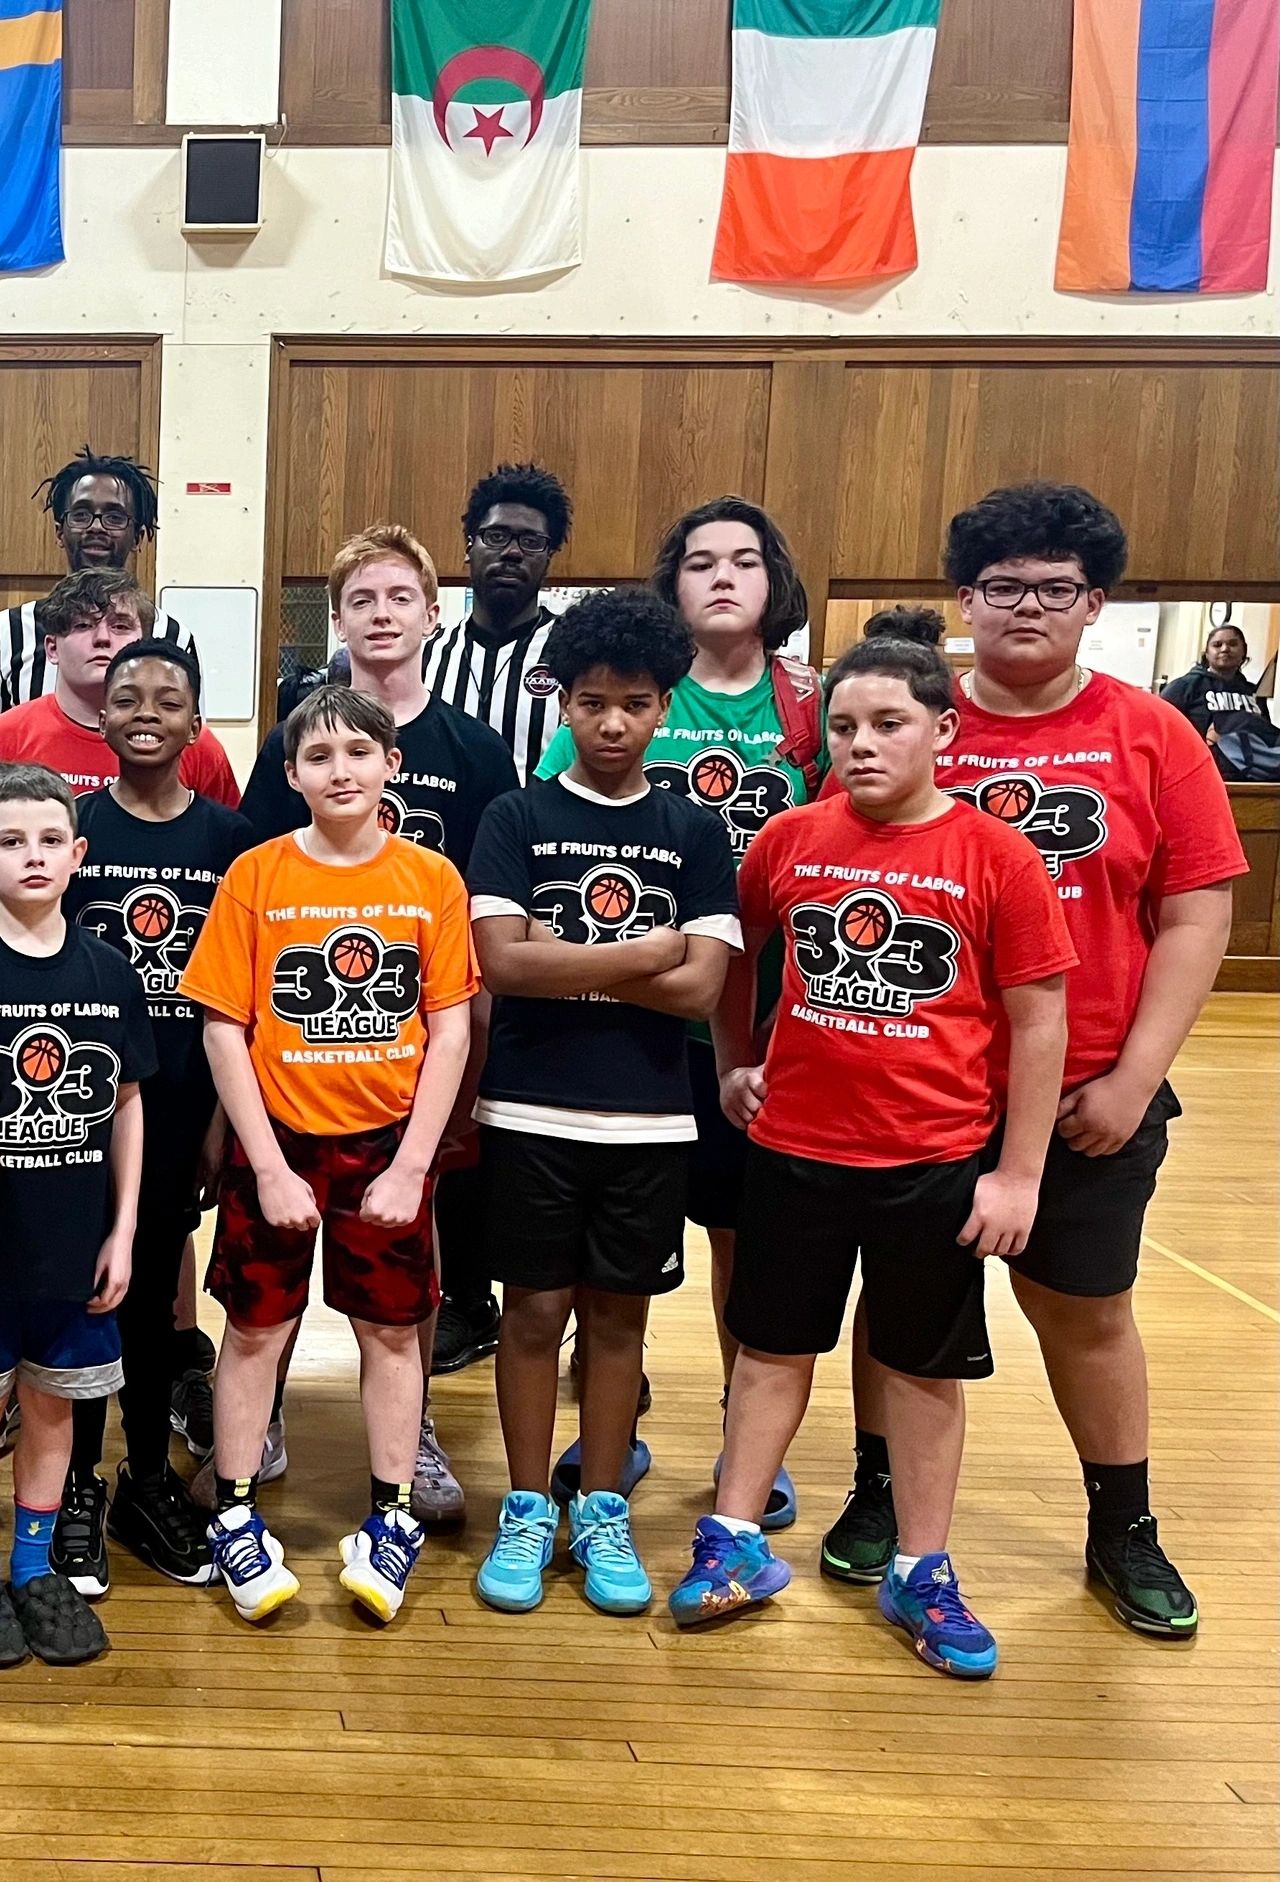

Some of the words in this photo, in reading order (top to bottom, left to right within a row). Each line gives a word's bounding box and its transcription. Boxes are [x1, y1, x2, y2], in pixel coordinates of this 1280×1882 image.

[653, 727, 671, 738] HE
[673, 728, 724, 741] FRUITS
[935, 755, 953, 767] HE
[957, 755, 1019, 769] FRUITS
[1024, 755, 1049, 768] OF
[1052, 751, 1112, 765] LABOR
[60, 772, 100, 787] RUITS
[413, 773, 457, 792] LABOR
[532, 842, 558, 856] THE
[561, 842, 617, 858] FRUITS
[621, 845, 641, 858] OF
[78, 865, 101, 878] THE
[105, 865, 157, 879] FRUITS
[161, 868, 182, 880] OF
[793, 865, 821, 877] THE
[823, 865, 881, 883] FRUITS
[885, 872, 909, 885] OF
[911, 874, 965, 899] LABOR
[266, 906, 296, 923] THE
[300, 906, 358, 919] FRUITS
[362, 905, 384, 919] OF
[810, 978, 908, 1010] LEAGUE
[51, 1003, 71, 1017] OF
[74, 1002, 120, 1018] LABOR
[307, 1015, 397, 1036] LEAGUE
[791, 1004, 879, 1036] BASKETBALL
[883, 1023, 930, 1038] CLUB
[282, 1050, 384, 1064] BASKETBALL
[386, 1045, 416, 1061] CLUB
[65, 1150, 103, 1164] CLUB
